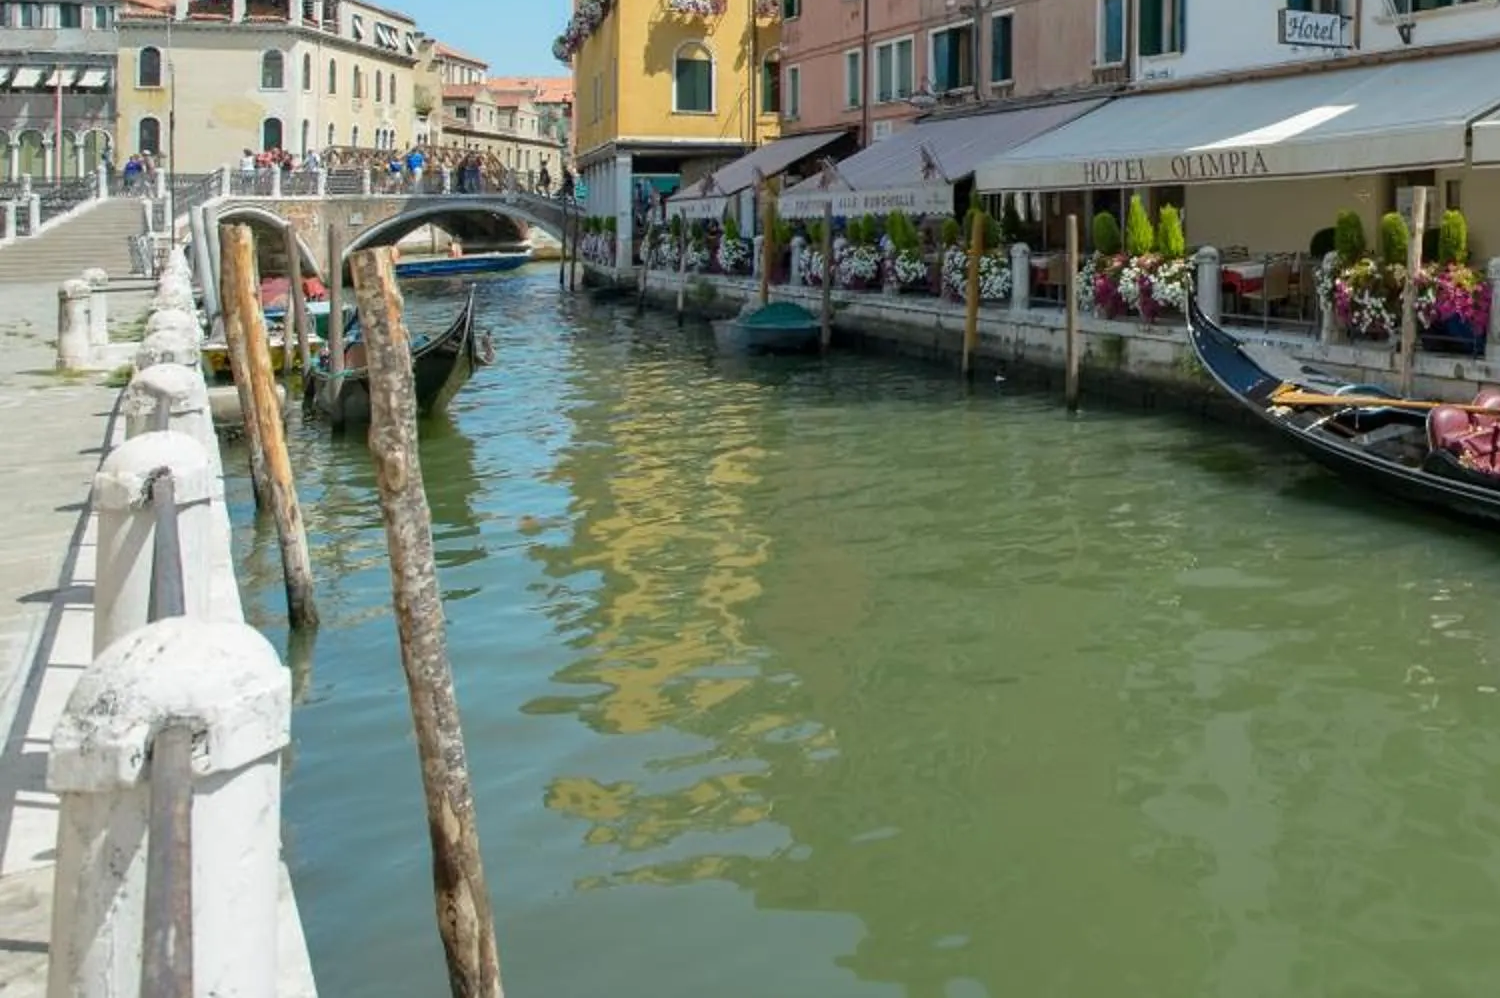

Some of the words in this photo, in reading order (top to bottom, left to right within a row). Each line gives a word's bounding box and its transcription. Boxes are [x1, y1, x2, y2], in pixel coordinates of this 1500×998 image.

[1288, 15, 1338, 40] Hotel
[1084, 158, 1150, 183] HOTEL
[1171, 149, 1268, 179] OLIMPIA
